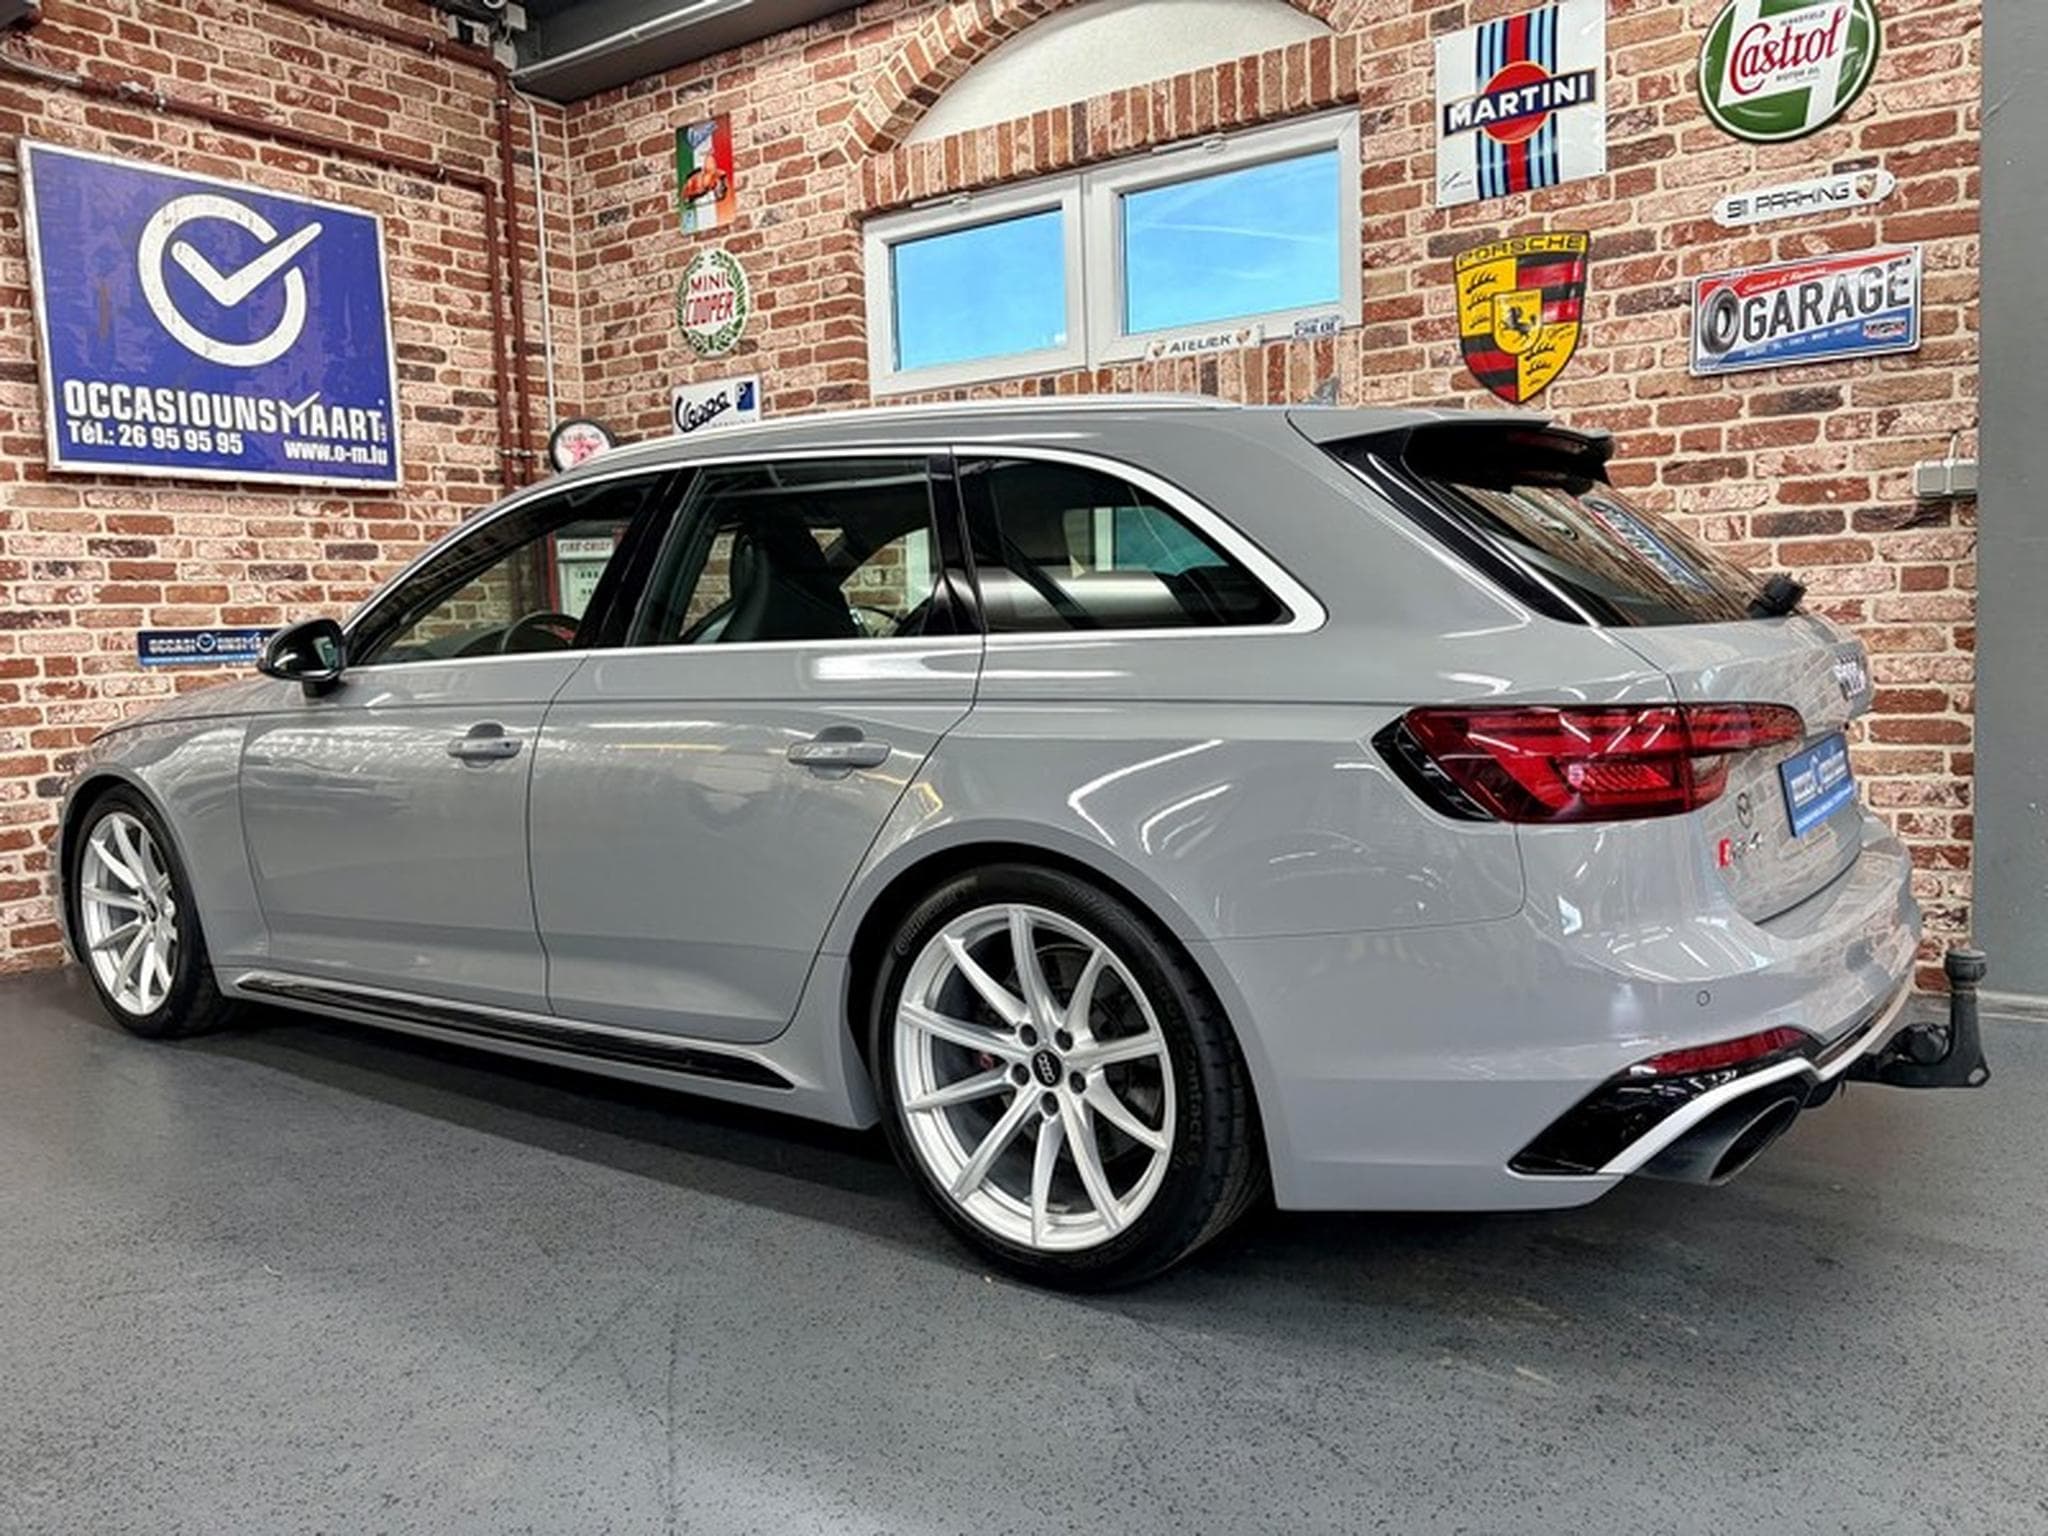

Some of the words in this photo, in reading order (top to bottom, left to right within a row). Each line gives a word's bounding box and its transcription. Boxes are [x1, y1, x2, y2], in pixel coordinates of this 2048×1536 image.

[1730, 5, 1847, 95] Castrol
[1449, 74, 1588, 131] MARTINI
[690, 271, 726, 295] MINI
[1742, 257, 1911, 343] GARAGE
[685, 291, 733, 327] COOPER
[118, 423, 147, 448] 26
[151, 426, 181, 450] 95
[183, 428, 212, 452] 95
[215, 431, 244, 455] 95
[283, 440, 388, 466] www.o-m.lu
